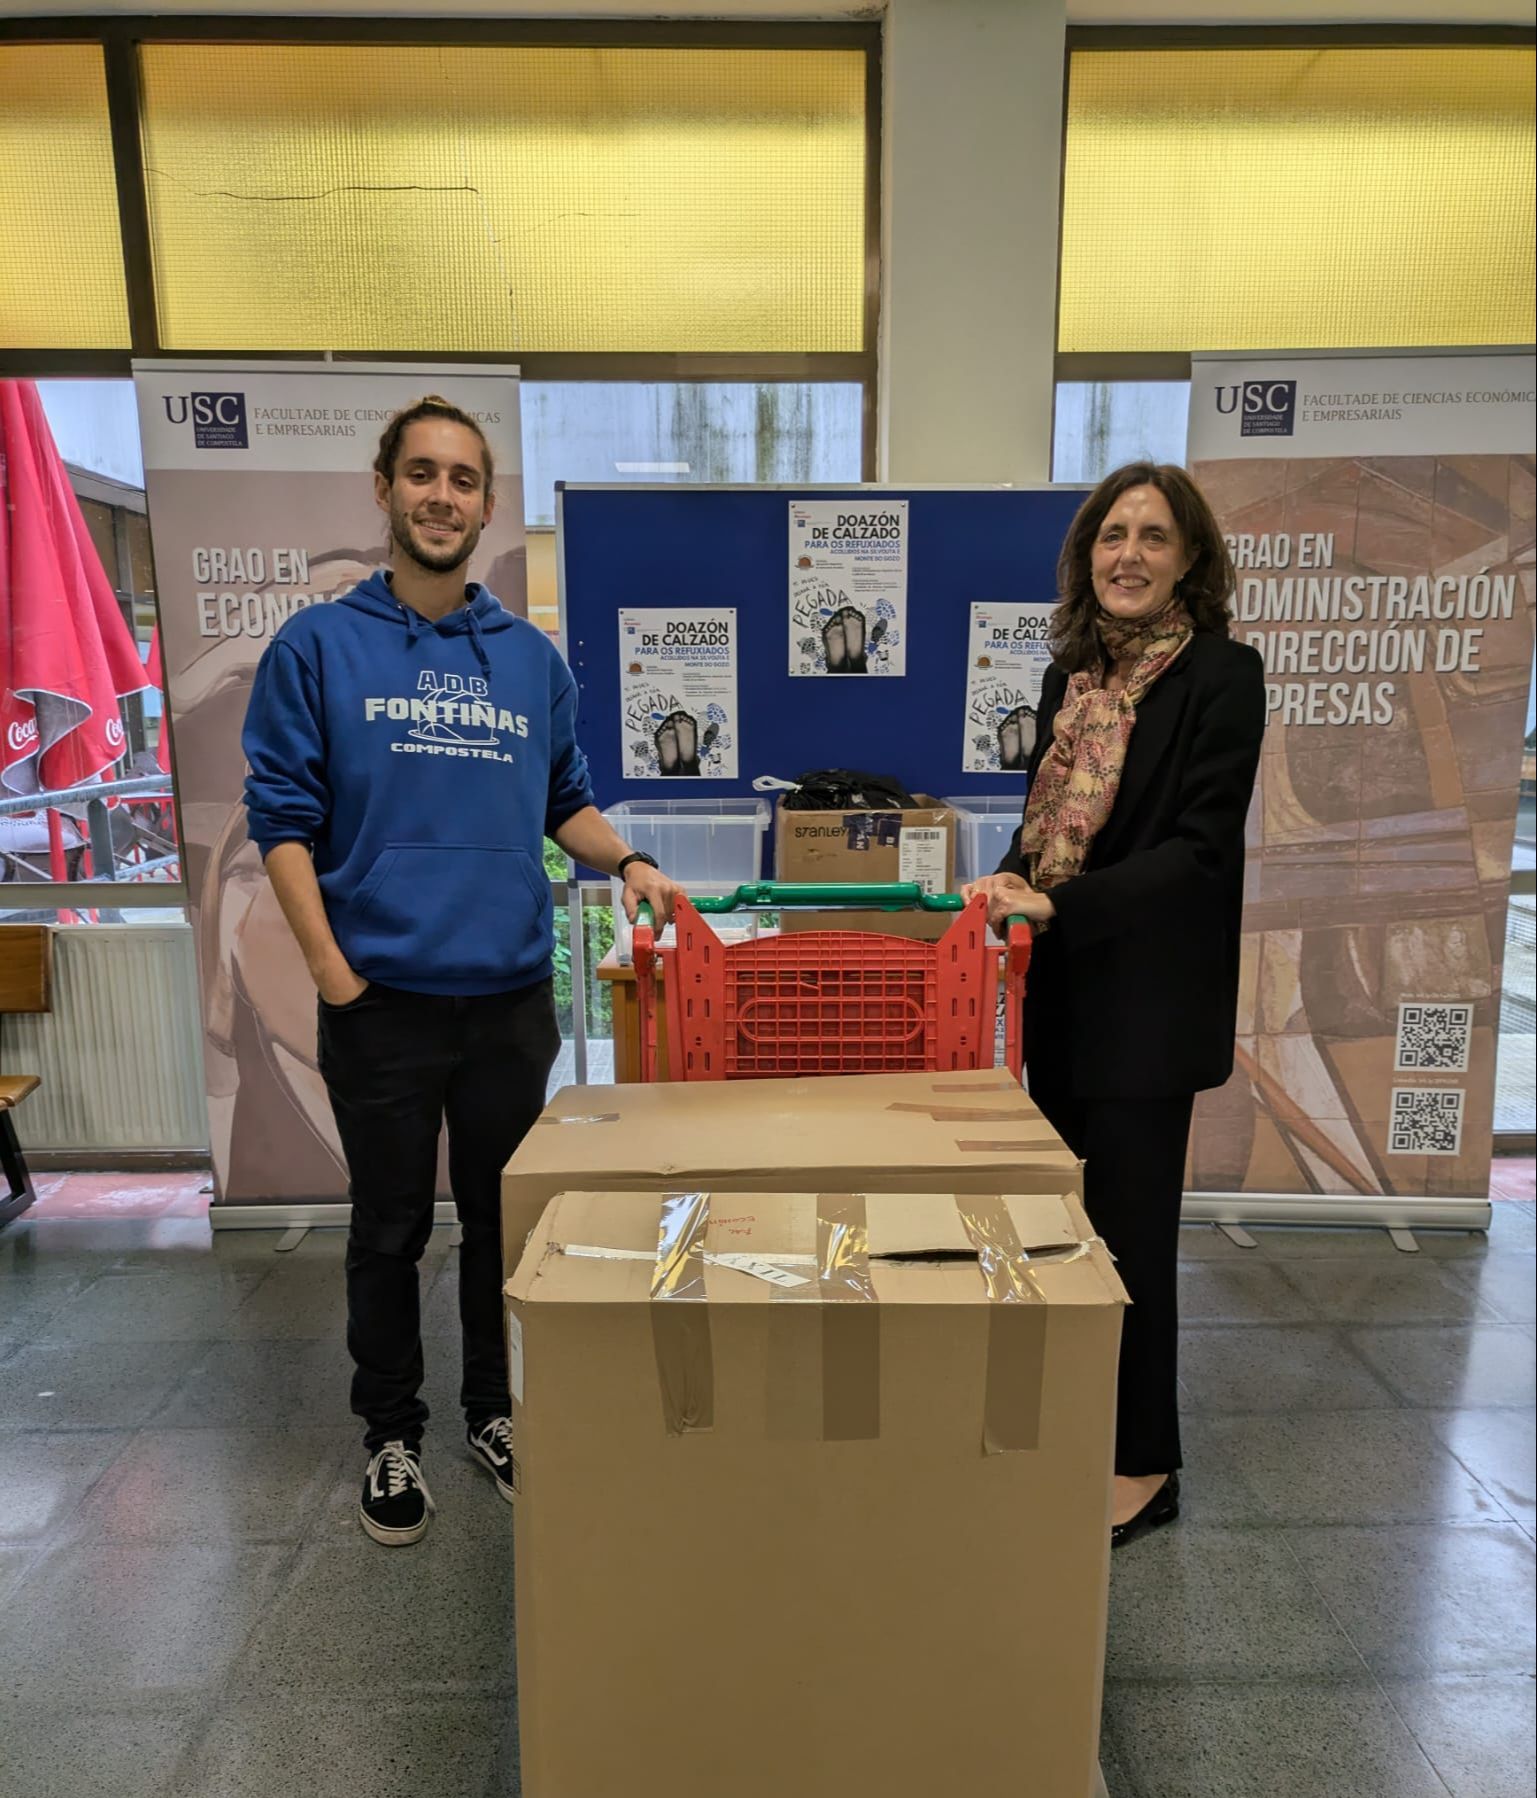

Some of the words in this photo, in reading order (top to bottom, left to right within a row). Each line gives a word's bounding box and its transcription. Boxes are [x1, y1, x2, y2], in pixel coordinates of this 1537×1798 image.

[1214, 384, 1289, 414] USC
[1303, 393, 1381, 406] FACULTADE
[1382, 393, 1399, 405] DE
[1402, 392, 1462, 405] CIENCIAS
[162, 395, 240, 425] USC
[254, 408, 330, 420] FACULTADE
[334, 409, 351, 421] DE
[354, 409, 392, 422] CIENC
[1302, 411, 1311, 422] E
[1313, 408, 1402, 422] EMPRESARIAIS
[255, 424, 264, 435] E
[267, 424, 356, 437] EMPRESARIAIS
[836, 510, 900, 527] DOAZÓN
[811, 528, 829, 540] DE
[832, 527, 901, 540] CALZADO
[804, 540, 829, 549] PARA
[830, 540, 844, 549] OS
[845, 540, 901, 549] REFUXIADOS
[1297, 532, 1334, 569] EN
[192, 547, 266, 584] GRAO
[273, 548, 310, 585] EN
[197, 591, 343, 638] ECON
[792, 588, 853, 628] PEGADA
[666, 618, 729, 634] DOAZÓN
[1018, 617, 1048, 628] DOA
[641, 634, 659, 646] DE
[662, 634, 729, 646] CALZADO
[984, 640, 1008, 649] PARA
[1010, 641, 1023, 649] OS
[992, 629, 1009, 640] DE
[1013, 629, 1049, 641] CALZ
[634, 647, 659, 655] PARA
[660, 647, 673, 655] OS
[675, 646, 730, 655] REFUXIADOS
[1435, 628, 1484, 673] DE
[416, 670, 489, 697] ADB
[625, 693, 684, 732] PEGADA
[969, 687, 1030, 726] PEGADA
[1264, 682, 1396, 727] PRESAS
[364, 697, 529, 739] FONTIÑAS
[390, 742, 514, 763] COMPOSTELA
